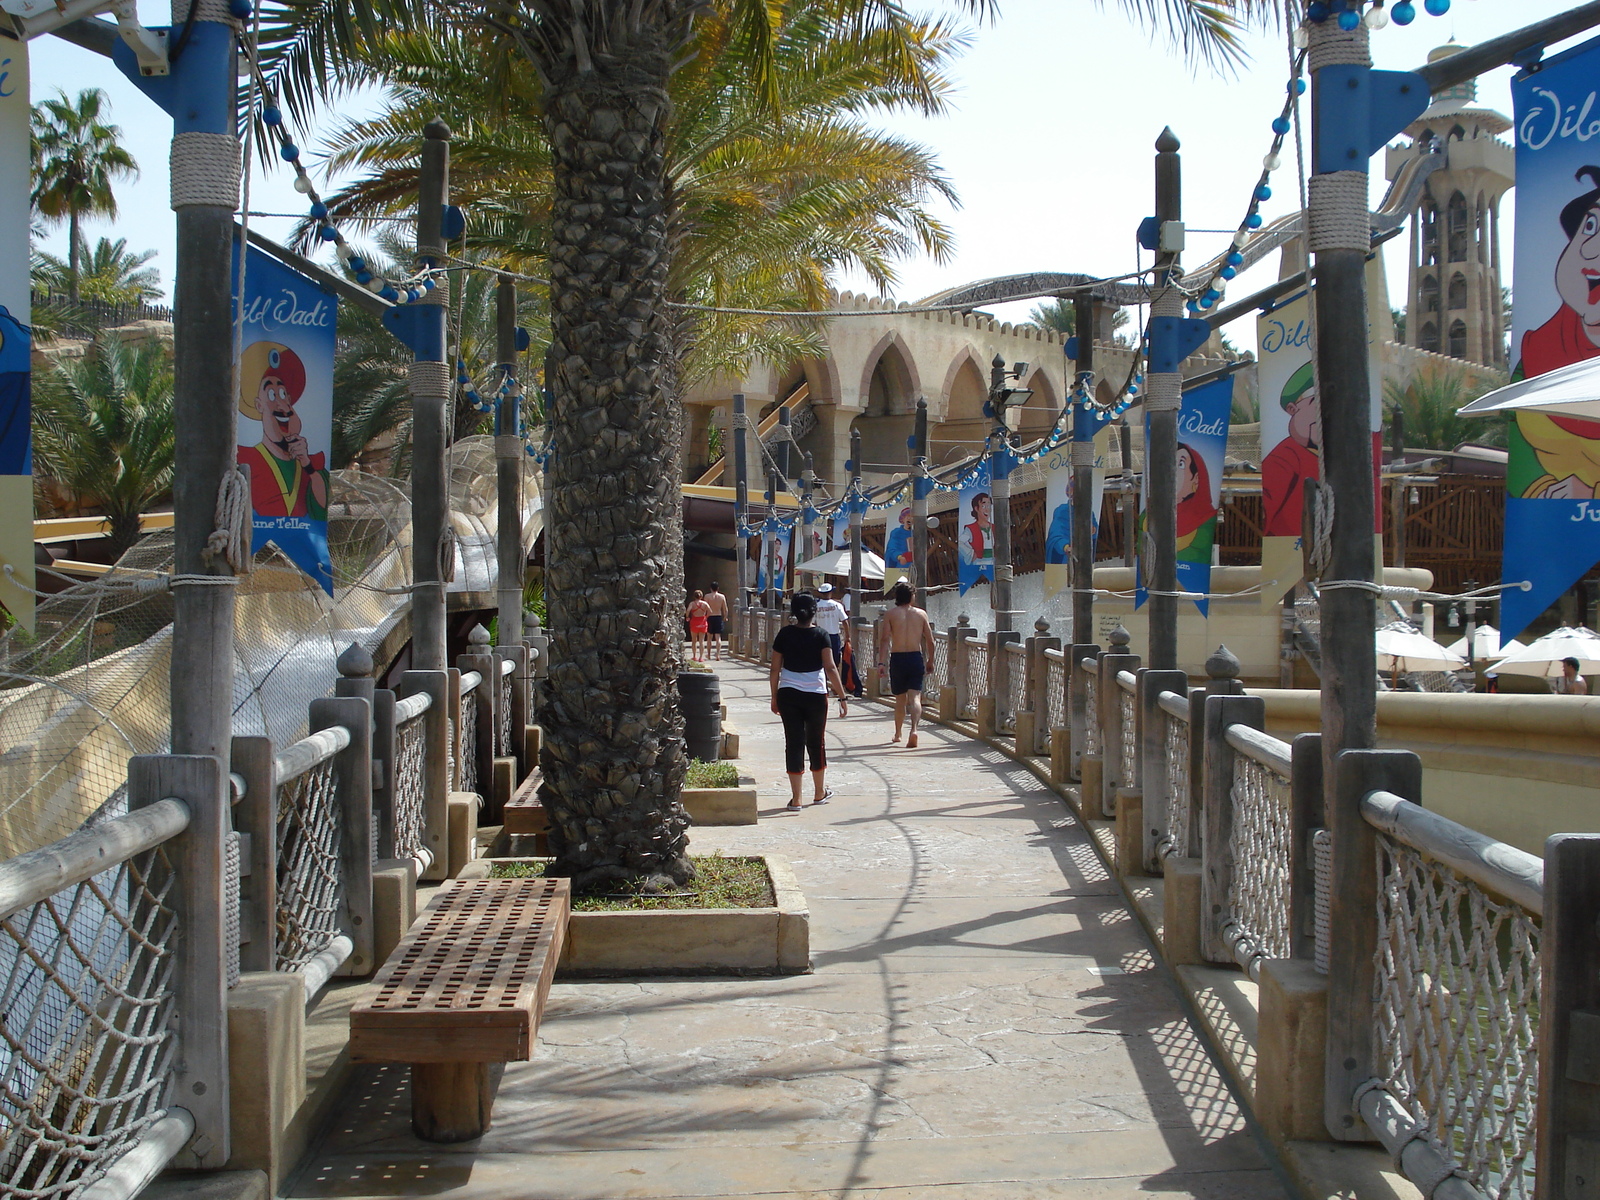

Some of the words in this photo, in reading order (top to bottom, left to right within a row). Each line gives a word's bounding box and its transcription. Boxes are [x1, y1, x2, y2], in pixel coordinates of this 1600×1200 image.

[273, 289, 329, 326] Wadi
[1186, 409, 1225, 436] Wadi
[276, 517, 311, 530] Teller
